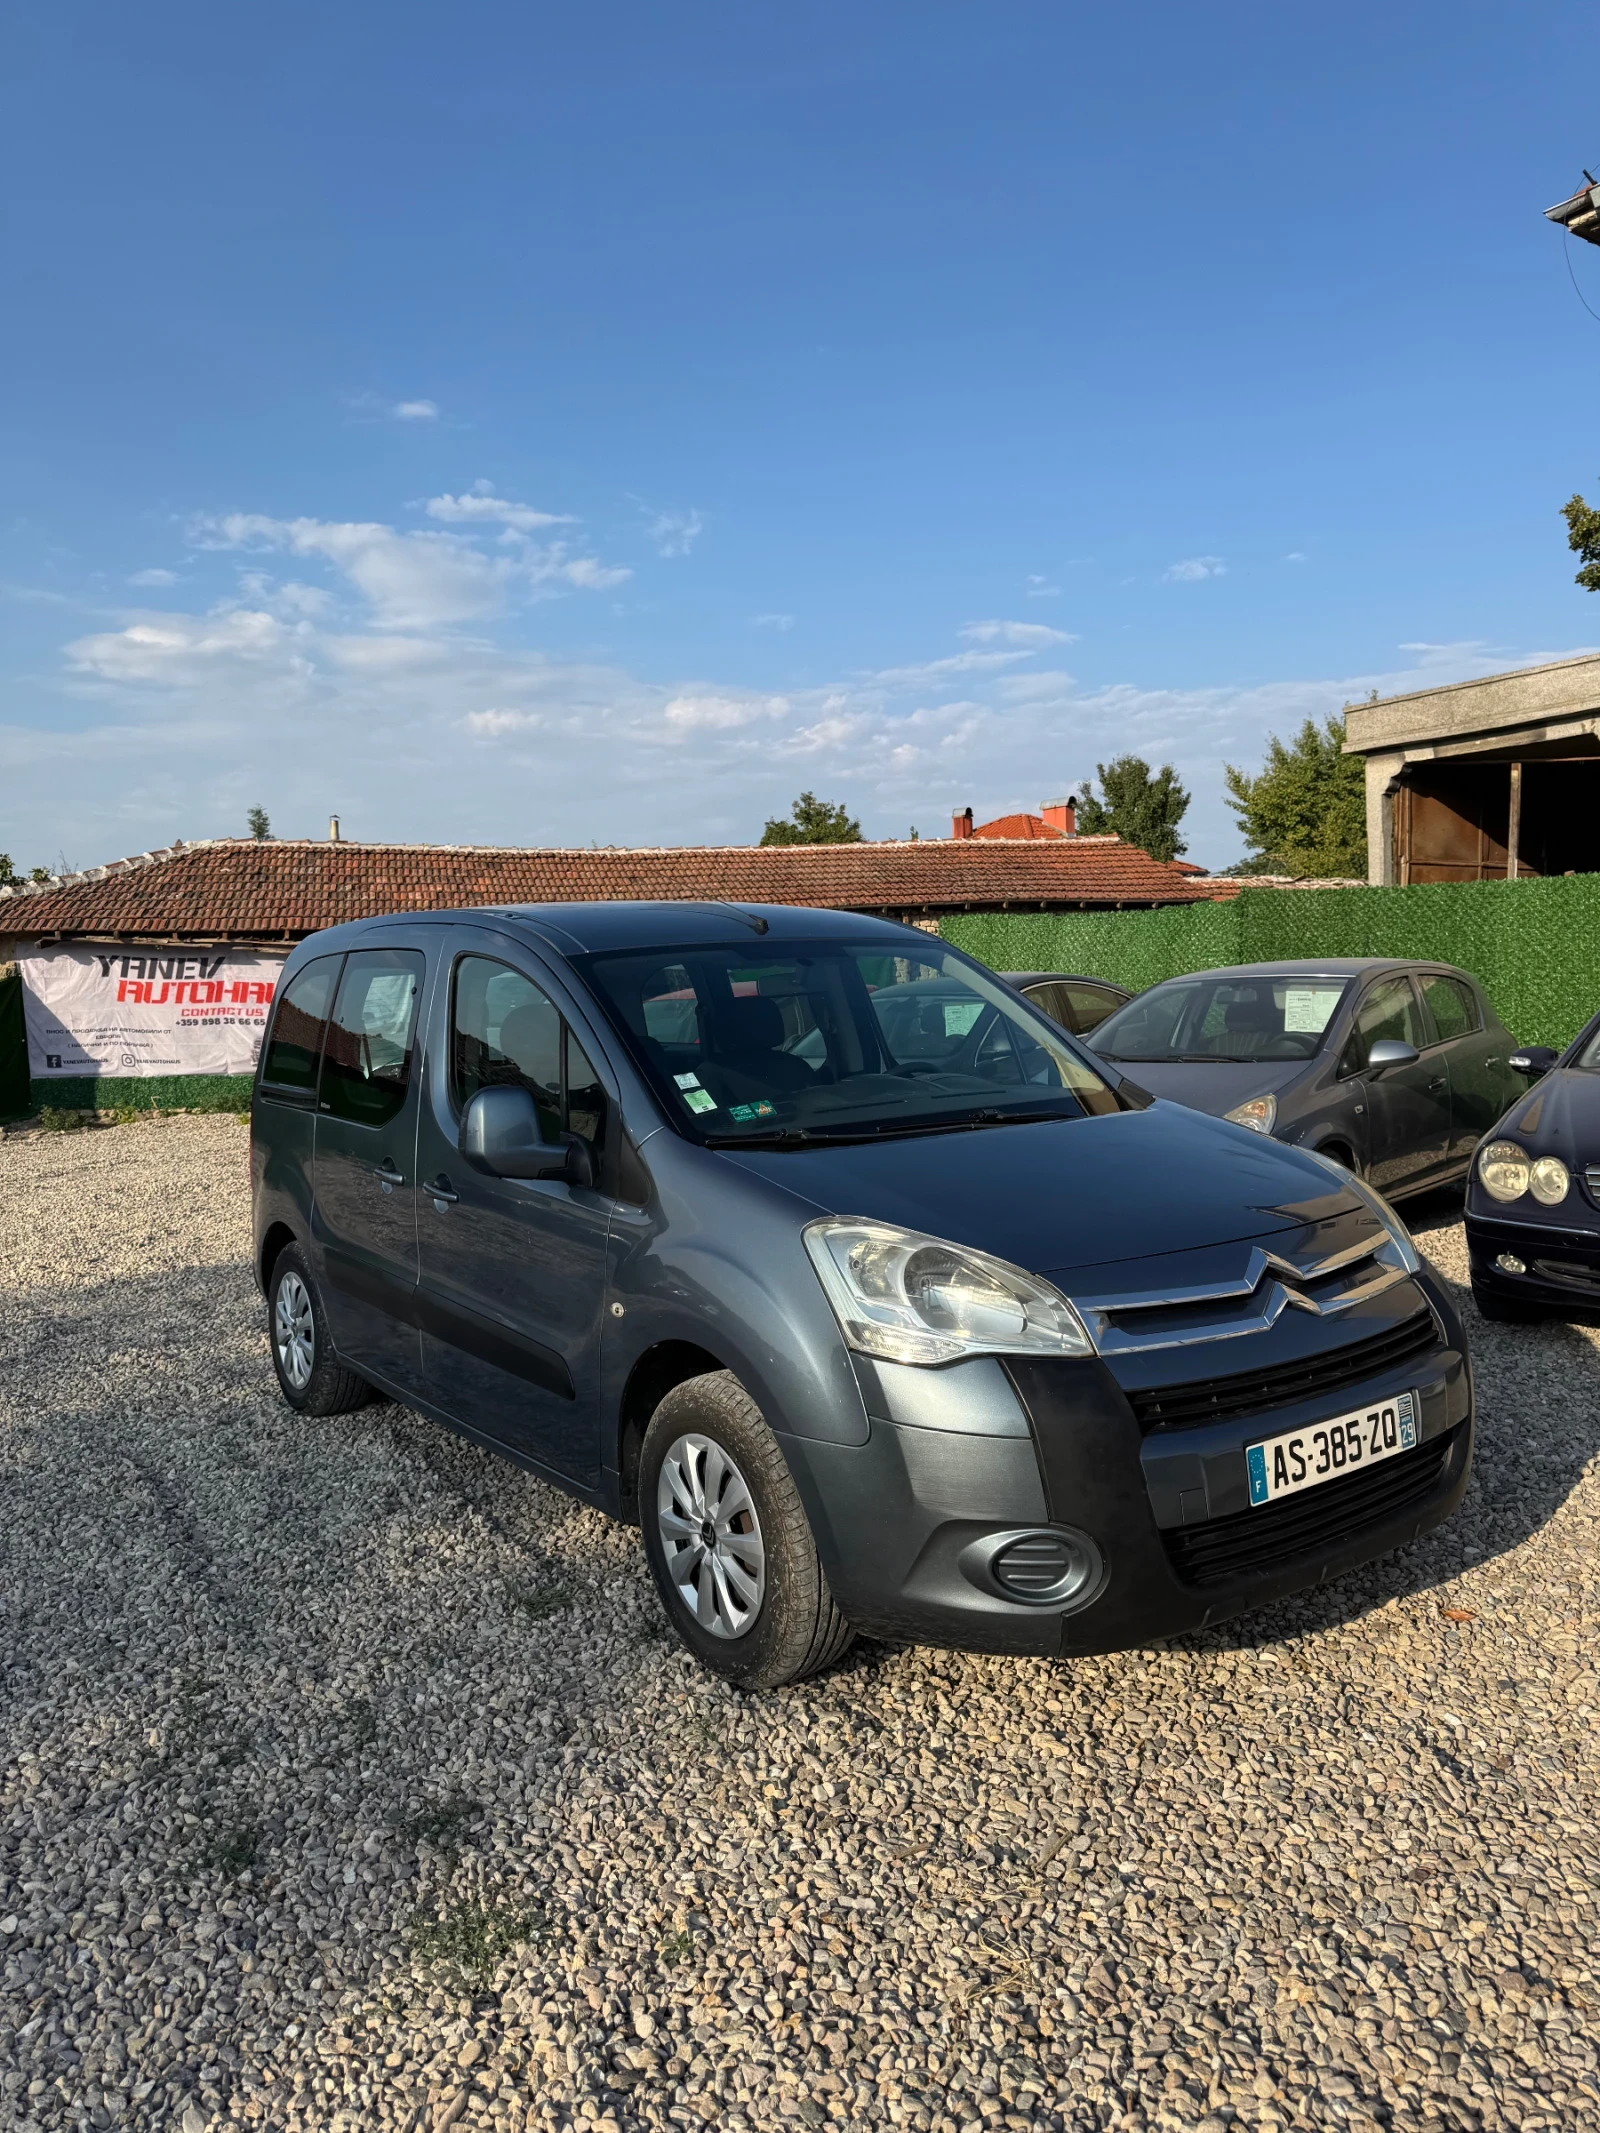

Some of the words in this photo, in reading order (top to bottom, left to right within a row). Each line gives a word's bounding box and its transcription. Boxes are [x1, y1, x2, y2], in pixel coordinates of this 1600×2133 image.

[96, 954, 226, 980] YANEV
[181, 1007, 242, 1017] CONTACT
[246, 1008, 264, 1017] US
[175, 1018, 199, 1026] +359
[201, 1017, 221, 1025] 898
[223, 1017, 236, 1025] 38
[238, 1018, 251, 1026] 66
[253, 1018, 266, 1026] 65
[1255, 1480, 1262, 1494] F
[1274, 1408, 1397, 1490] AS-385-ZQ
[1401, 1422, 1414, 1444] 29
